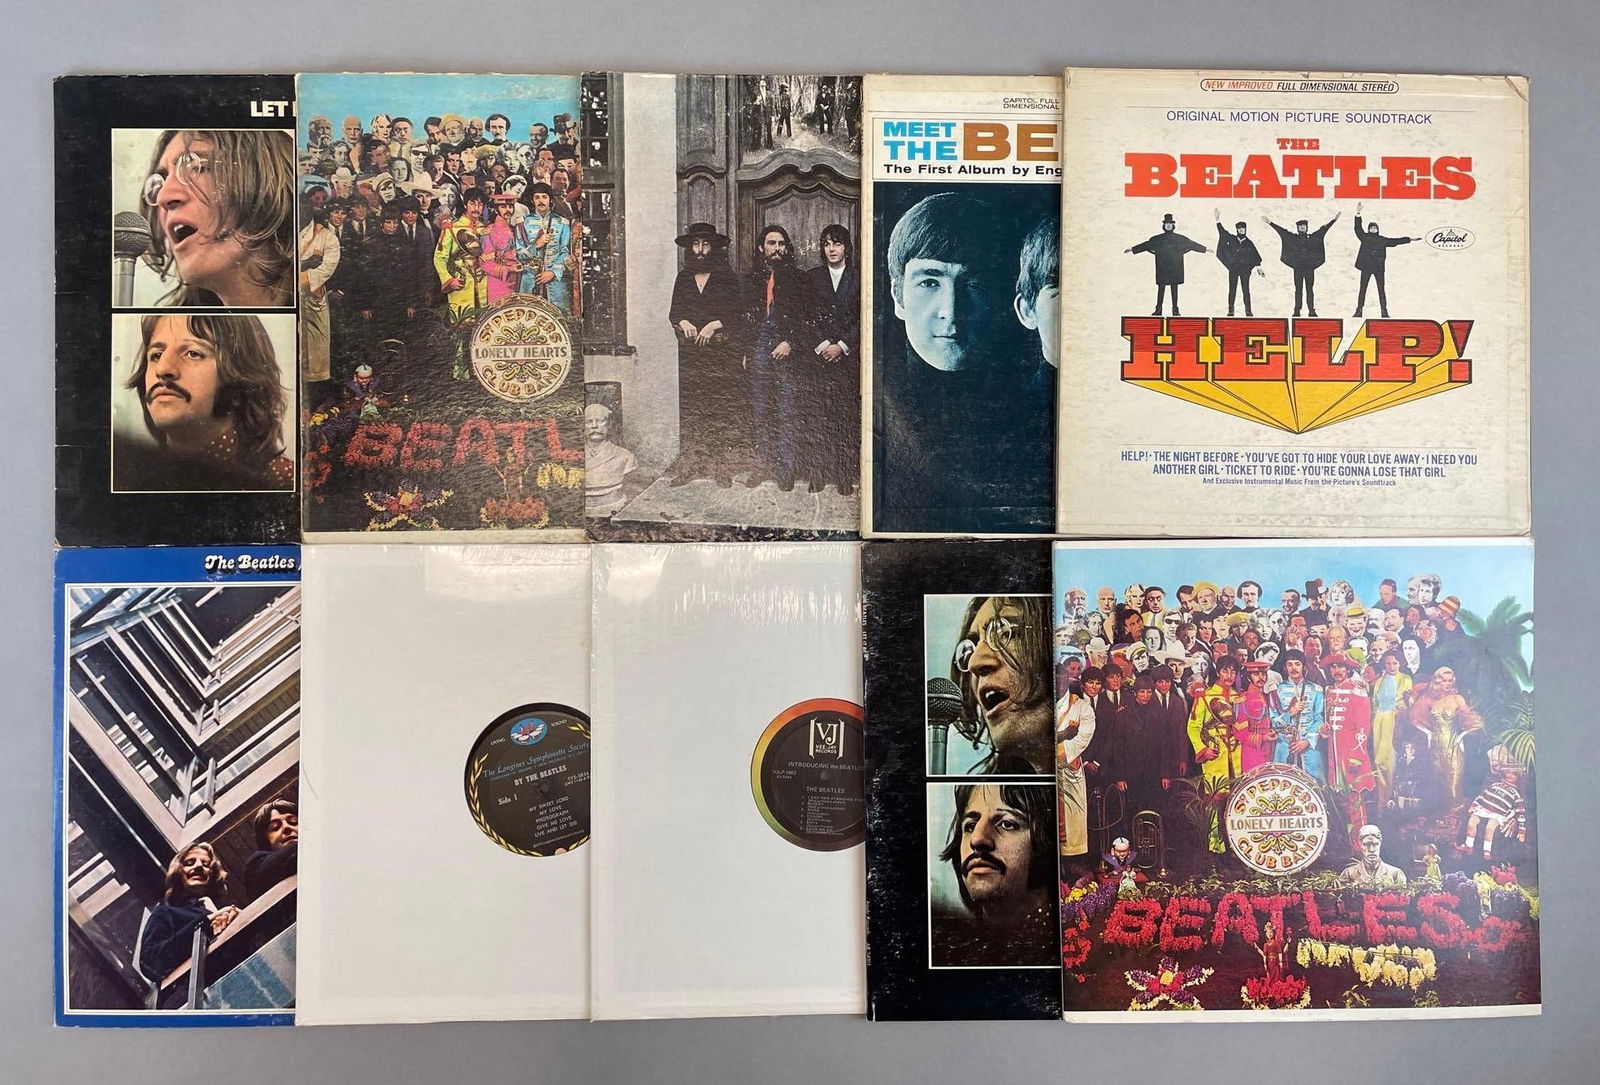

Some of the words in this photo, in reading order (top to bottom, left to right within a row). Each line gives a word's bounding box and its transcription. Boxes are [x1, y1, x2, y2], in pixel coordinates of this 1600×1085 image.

[1204, 80, 1225, 89] NEW
[1228, 81, 1273, 90] IMPROVED
[1276, 82, 1296, 90] FULL
[1300, 82, 1358, 91] DIMENSIONAL
[1362, 83, 1394, 92] STEREO
[250, 100, 288, 117] LET
[1166, 110, 1225, 122] ORIGINAL
[1230, 110, 1280, 123] MOTION
[1285, 111, 1340, 124] PICTURE
[1345, 112, 1432, 124] SOUNDTRACK
[883, 121, 956, 138] MEET
[883, 140, 958, 161] THE
[1276, 138, 1320, 150] THE
[884, 164, 912, 174] The
[918, 164, 952, 174] First
[958, 165, 1005, 175] Album
[1012, 165, 1029, 177] by
[1124, 152, 1476, 200] BEATLES
[1432, 232, 1468, 244] Capitol
[474, 347, 518, 359] LONELY
[523, 346, 568, 358] HEARTS
[1120, 316, 1474, 385] HELP!
[482, 365, 520, 396] CLUB
[524, 364, 562, 396] BAND
[1120, 450, 1148, 462] HELP!
[1154, 451, 1171, 462] THE
[1173, 451, 1200, 462] NIGHT
[1203, 452, 1239, 462] BEFORE
[1245, 452, 1279, 463] YOU'VE
[1282, 452, 1300, 463] GOT
[1302, 453, 1314, 464] TO
[1316, 453, 1337, 464] HIDE
[1340, 454, 1366, 464] YOUR
[1367, 454, 1391, 464] LOVE
[1394, 454, 1420, 465] AWAY
[1426, 455, 1430, 465] I
[1432, 455, 1456, 465] NEED
[1458, 455, 1478, 465] YOU
[1152, 464, 1196, 475] ANOTHER
[1199, 464, 1220, 475] GIRL
[1225, 465, 1257, 475] TICKET
[1261, 465, 1273, 475] TO
[1274, 465, 1296, 476] RIDE
[1301, 466, 1336, 476] YOU'RE
[1338, 466, 1371, 477] GONNA
[1372, 466, 1397, 477] LOSE
[1399, 467, 1422, 477] THAT
[1424, 467, 1446, 478] GIRL
[204, 554, 235, 570] The
[238, 554, 295, 570] Beatles
[815, 722, 839, 745] VJ
[484, 769, 495, 778] The
[514, 778, 523, 786] BY
[526, 774, 539, 783] THE
[540, 765, 567, 779] BEATLES
[498, 796, 512, 806] Side
[538, 801, 554, 809] SWEET
[549, 805, 562, 813] LOVE
[1230, 818, 1275, 830] LONELY
[1280, 817, 1323, 829] HEARTS
[1238, 837, 1277, 869] CLUB
[1281, 834, 1318, 868] BAND
[1102, 891, 1466, 953] BEATLES
